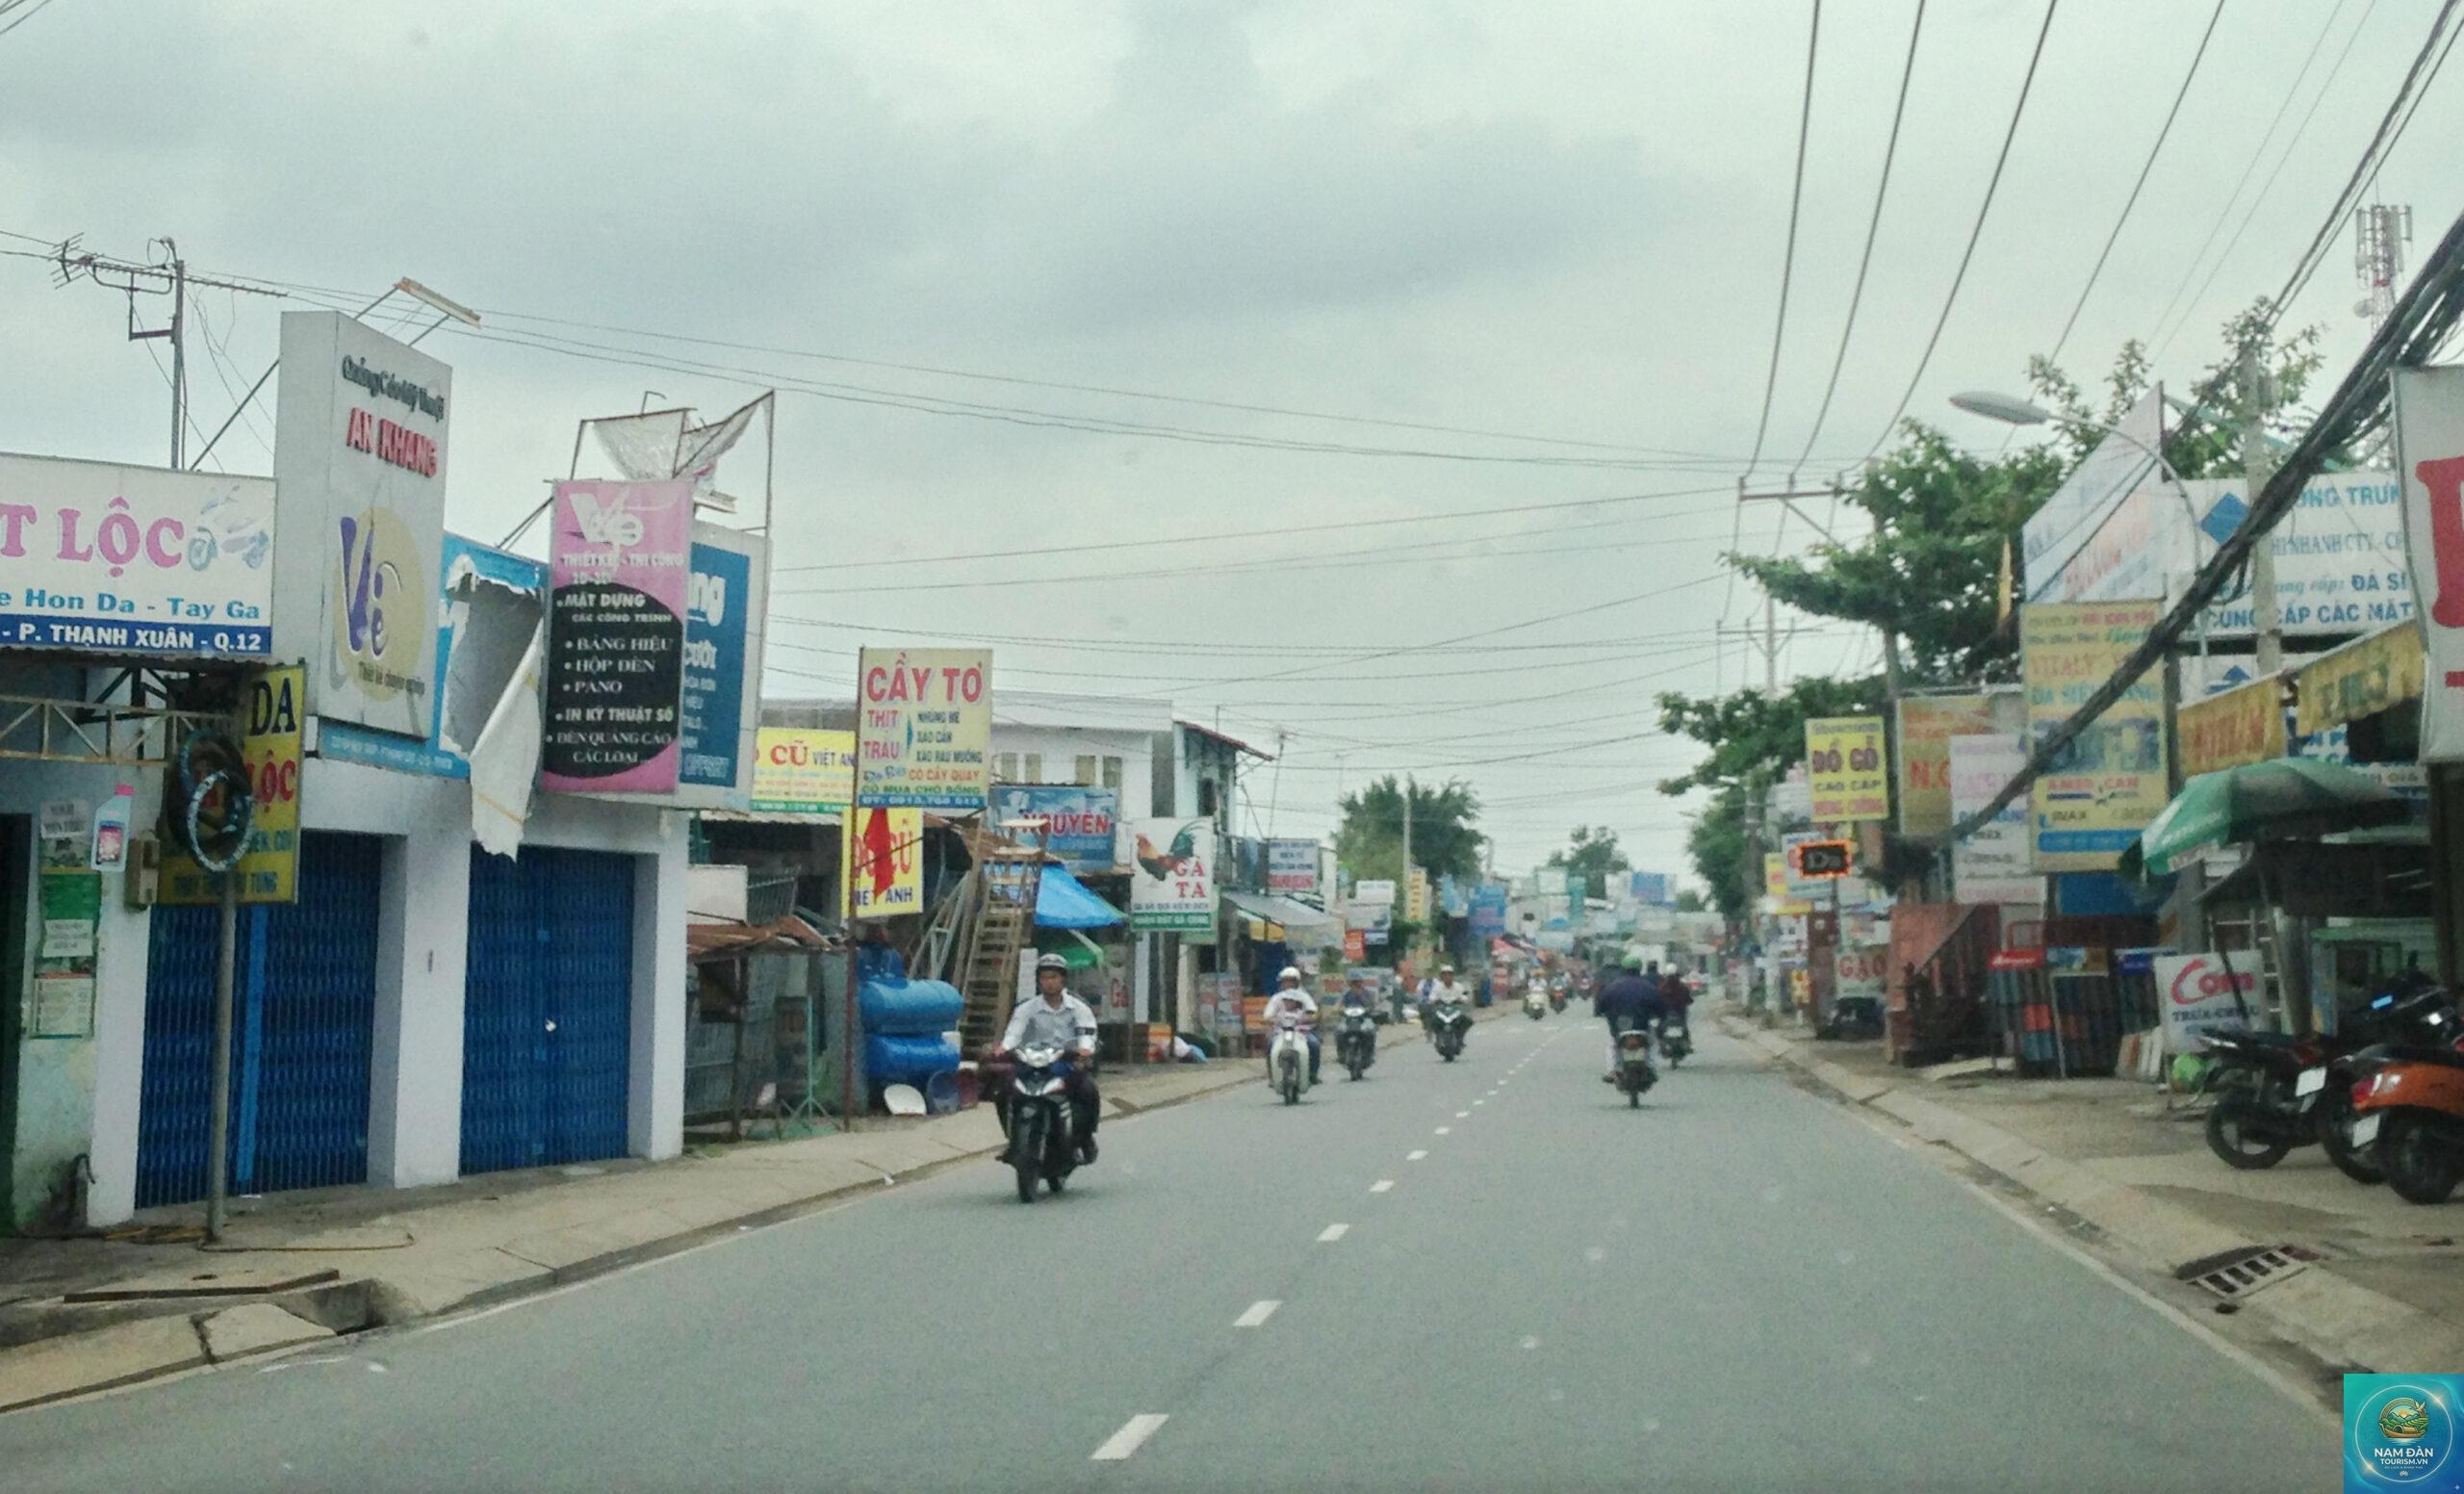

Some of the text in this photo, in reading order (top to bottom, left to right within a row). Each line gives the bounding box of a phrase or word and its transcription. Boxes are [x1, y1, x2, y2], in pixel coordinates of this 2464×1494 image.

[346, 406, 437, 478] AN KHANG
[57, 496, 185, 578] LỘC
[25, 588, 85, 610] Hon
[97, 593, 135, 614] Da
[167, 597, 216, 621] Tay
[226, 601, 261, 619] Ga
[19, 623, 41, 642] P.
[50, 624, 127, 648] THẠNH
[135, 628, 193, 650] XUÂN
[214, 633, 262, 653] Q.12
[576, 655, 614, 675] HỘP
[867, 651, 932, 703] CẦY
[575, 680, 623, 693] PANO
[250, 677, 296, 735] DA
[564, 708, 583, 722] IN
[885, 886, 913, 904] ANH
[1175, 881, 1207, 898] TA
